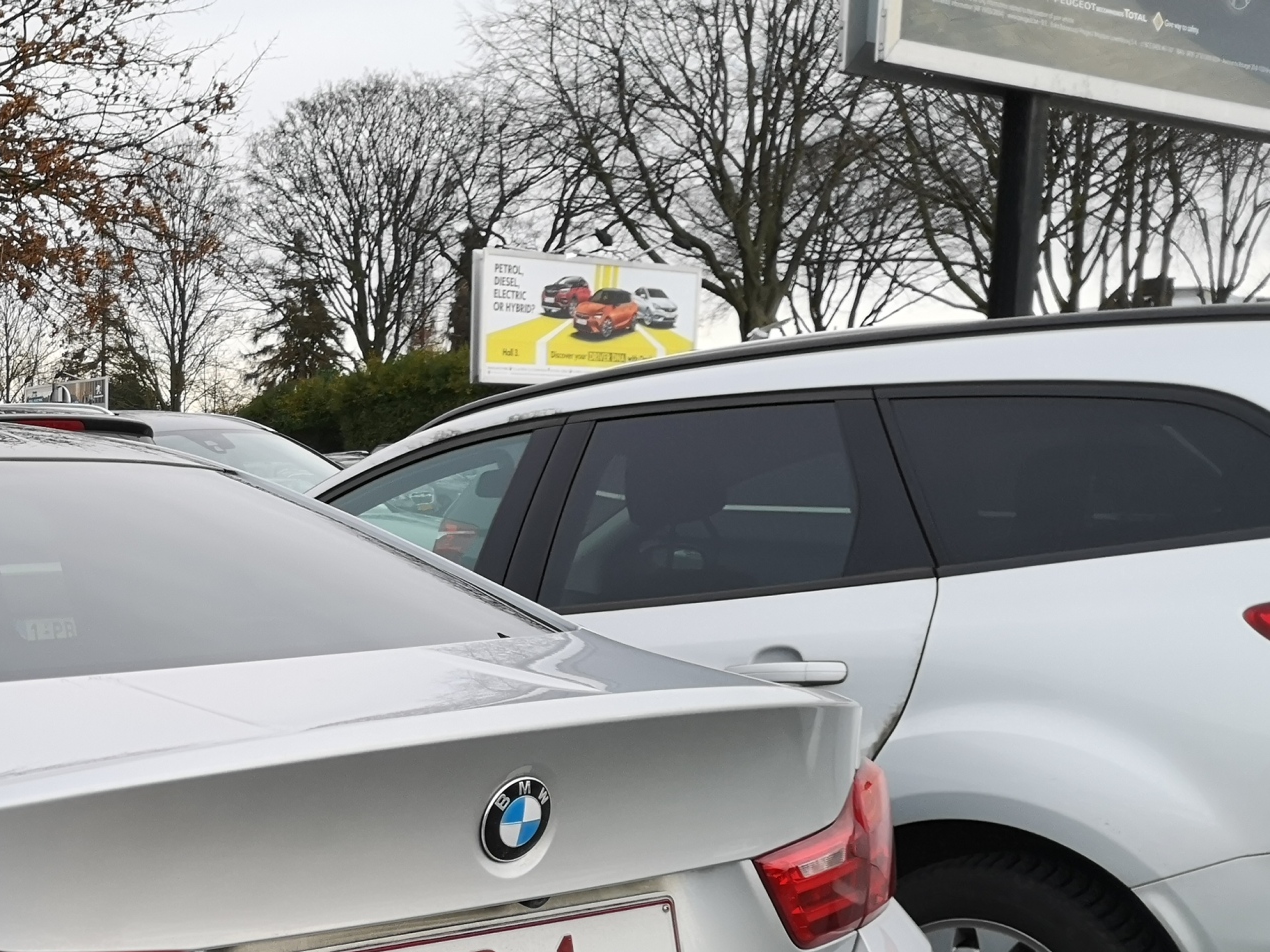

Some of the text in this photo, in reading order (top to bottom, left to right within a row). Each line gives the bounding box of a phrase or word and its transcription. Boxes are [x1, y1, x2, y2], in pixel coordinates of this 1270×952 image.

[1123, 8, 1147, 22] TOTAL
[494, 263, 524, 277] PETROL,
[494, 276, 520, 289] DIESEL,
[493, 288, 527, 301] ELECTRIC
[493, 301, 536, 314] OR HYBRID?
[502, 348, 514, 357] Hall
[494, 781, 549, 811] BMW
